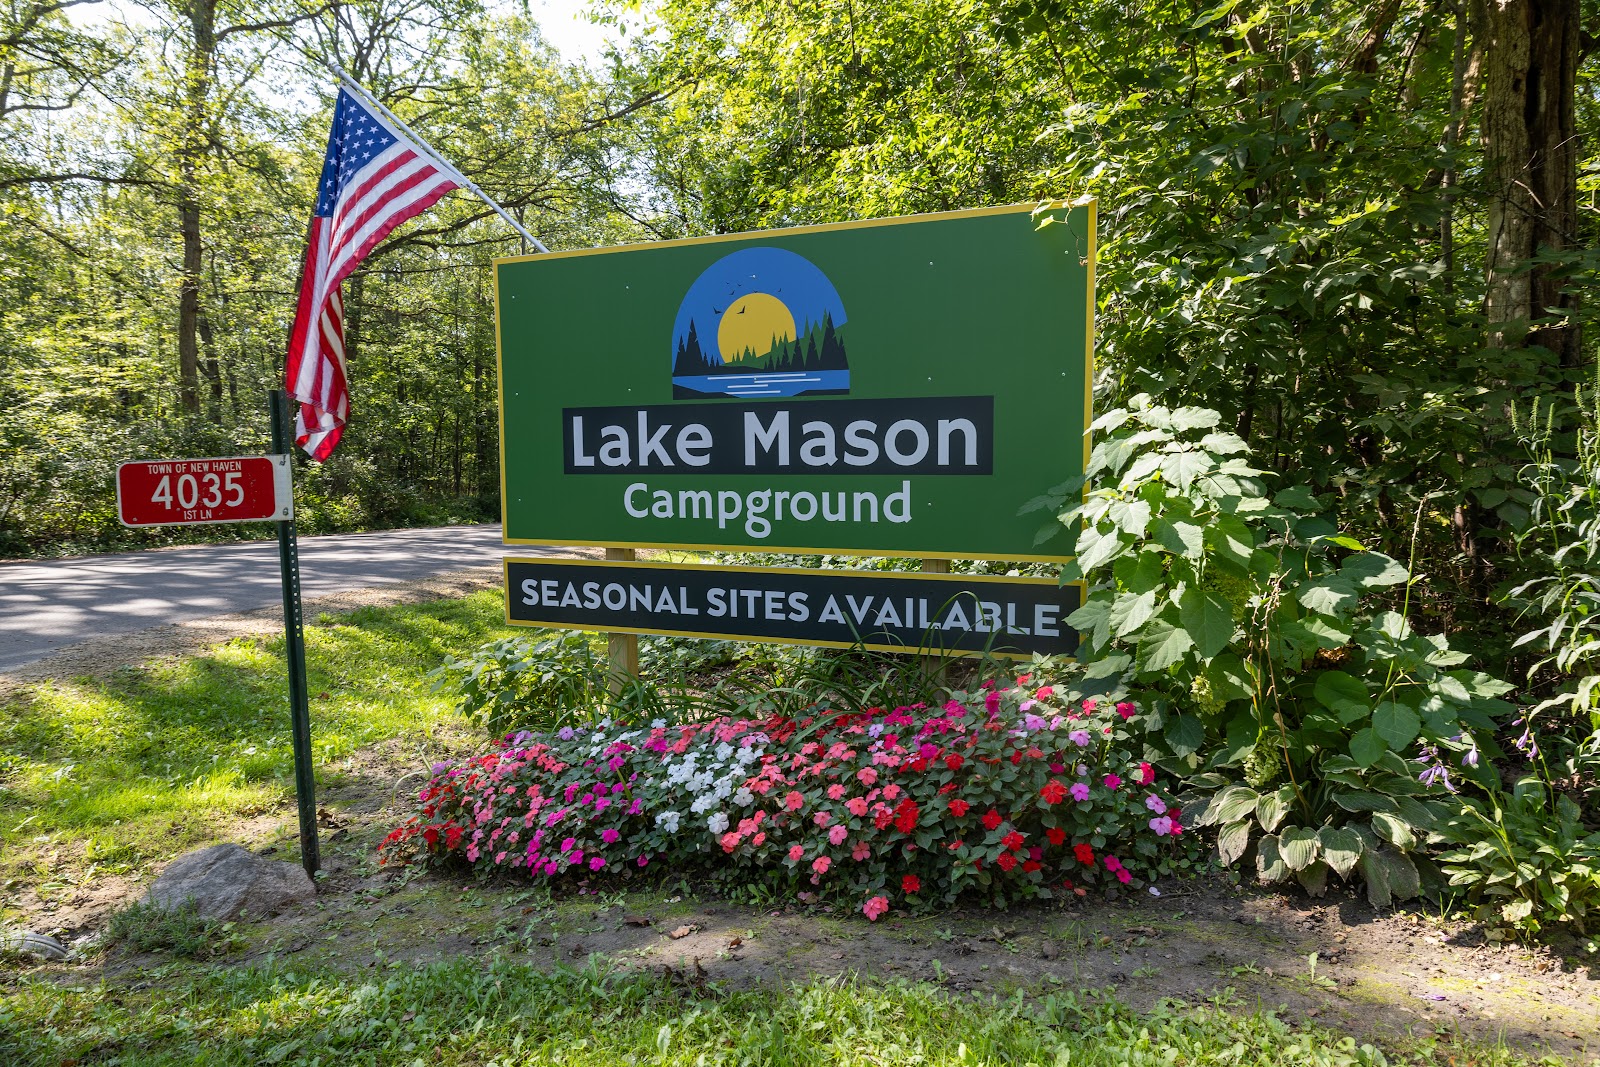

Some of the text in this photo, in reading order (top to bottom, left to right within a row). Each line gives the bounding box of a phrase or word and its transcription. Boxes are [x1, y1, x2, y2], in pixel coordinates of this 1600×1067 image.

[571, 410, 979, 468] Lake Mason
[147, 461, 242, 474] TOWN OF NEW HAVEN
[151, 472, 245, 510] 4035
[200, 509, 212, 520] LN
[623, 480, 912, 539] Campground
[521, 577, 1060, 637] SEASONAL SITES AVAILABLE
